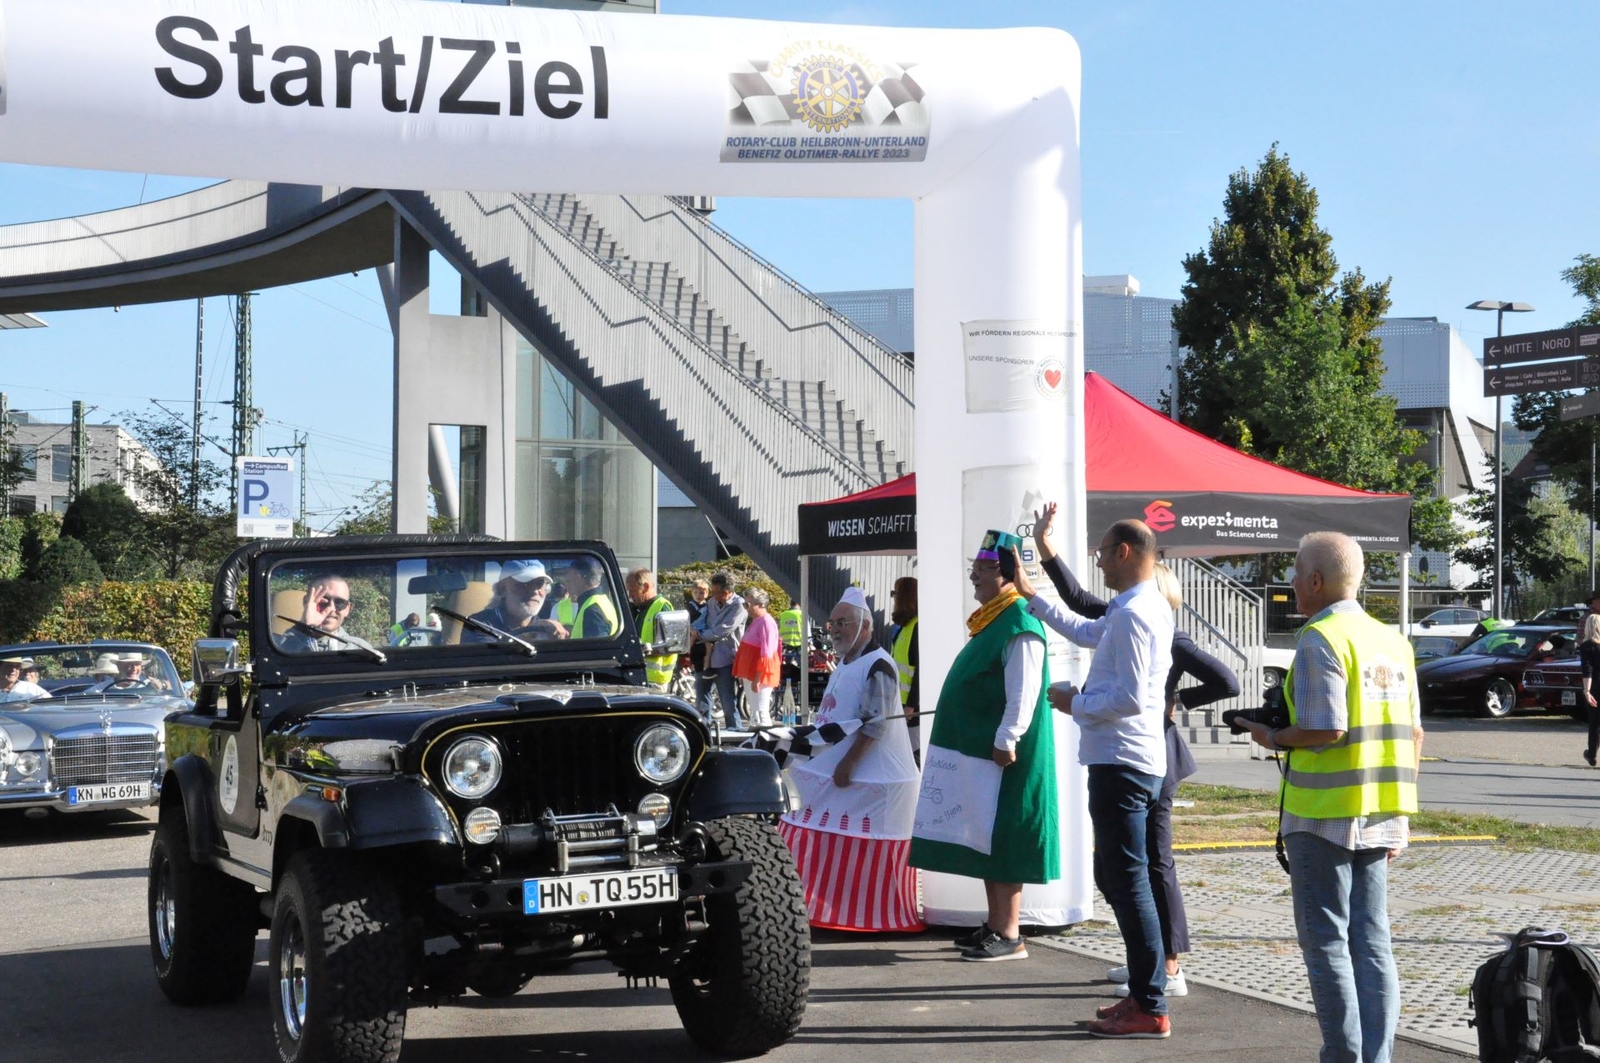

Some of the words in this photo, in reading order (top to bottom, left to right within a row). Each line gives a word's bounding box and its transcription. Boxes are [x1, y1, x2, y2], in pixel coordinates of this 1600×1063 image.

[154, 15, 609, 120] Start/Ziel
[803, 104, 855, 124] INTERNATIONAL
[726, 136, 797, 148] ROTARY-CLUB
[800, 136, 926, 147] HEILBRONN-UNTERLAND
[737, 149, 781, 159] BENEFIZ
[784, 149, 879, 159] OLDTIMER-RALLYE
[882, 149, 910, 159] 2023
[981, 329, 1012, 337] FÖRDERN
[1504, 342, 1533, 355] MITTE
[1542, 337, 1571, 350] NORD
[995, 356, 1034, 365] SPONSOREN
[243, 479, 270, 515] P
[827, 518, 865, 537] WISSEN
[867, 514, 912, 535] SCHAFFT
[1229, 530, 1255, 538] Science
[225, 764, 234, 787] 45
[77, 790, 93, 801] KN
[101, 787, 116, 798] WG
[119, 785, 141, 797] 69H
[539, 881, 573, 909] HN
